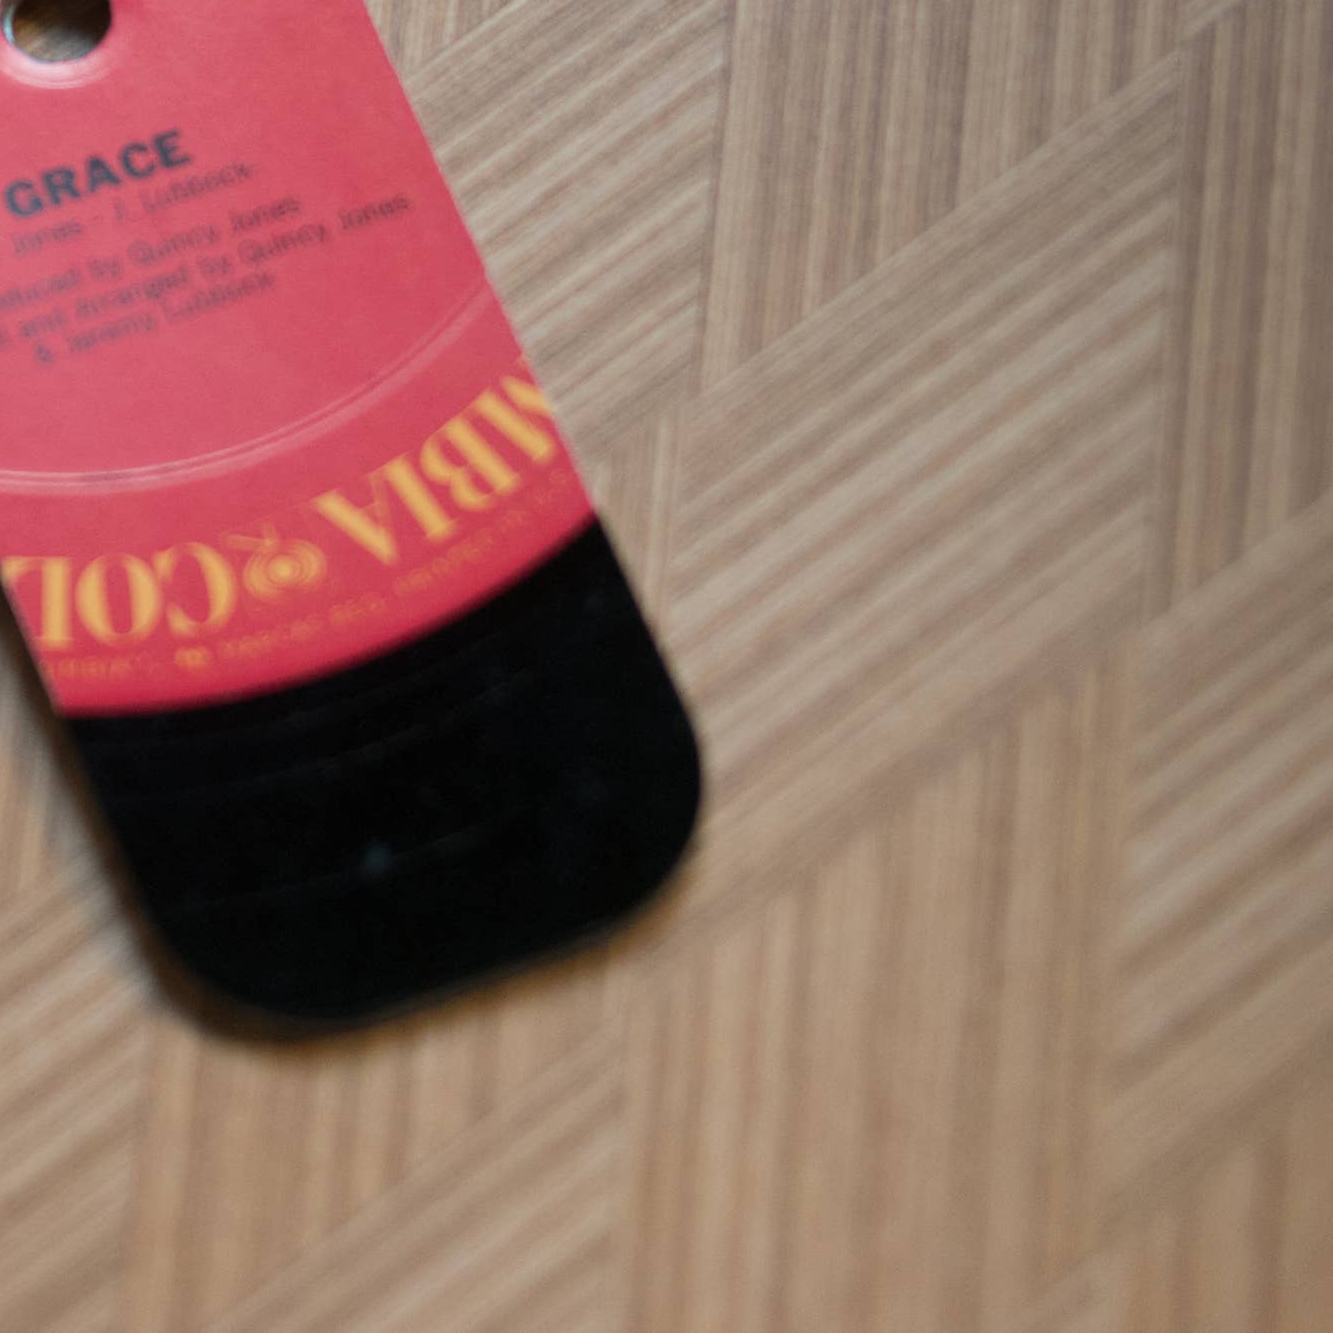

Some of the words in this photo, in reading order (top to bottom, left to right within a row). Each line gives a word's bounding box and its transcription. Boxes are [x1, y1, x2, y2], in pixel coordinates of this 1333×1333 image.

[2, 128, 194, 220] GRACE
[127, 223, 219, 267] Quincy
[230, 195, 302, 234] Jones
[237, 222, 327, 268] Quincy
[339, 191, 413, 233] Jones
